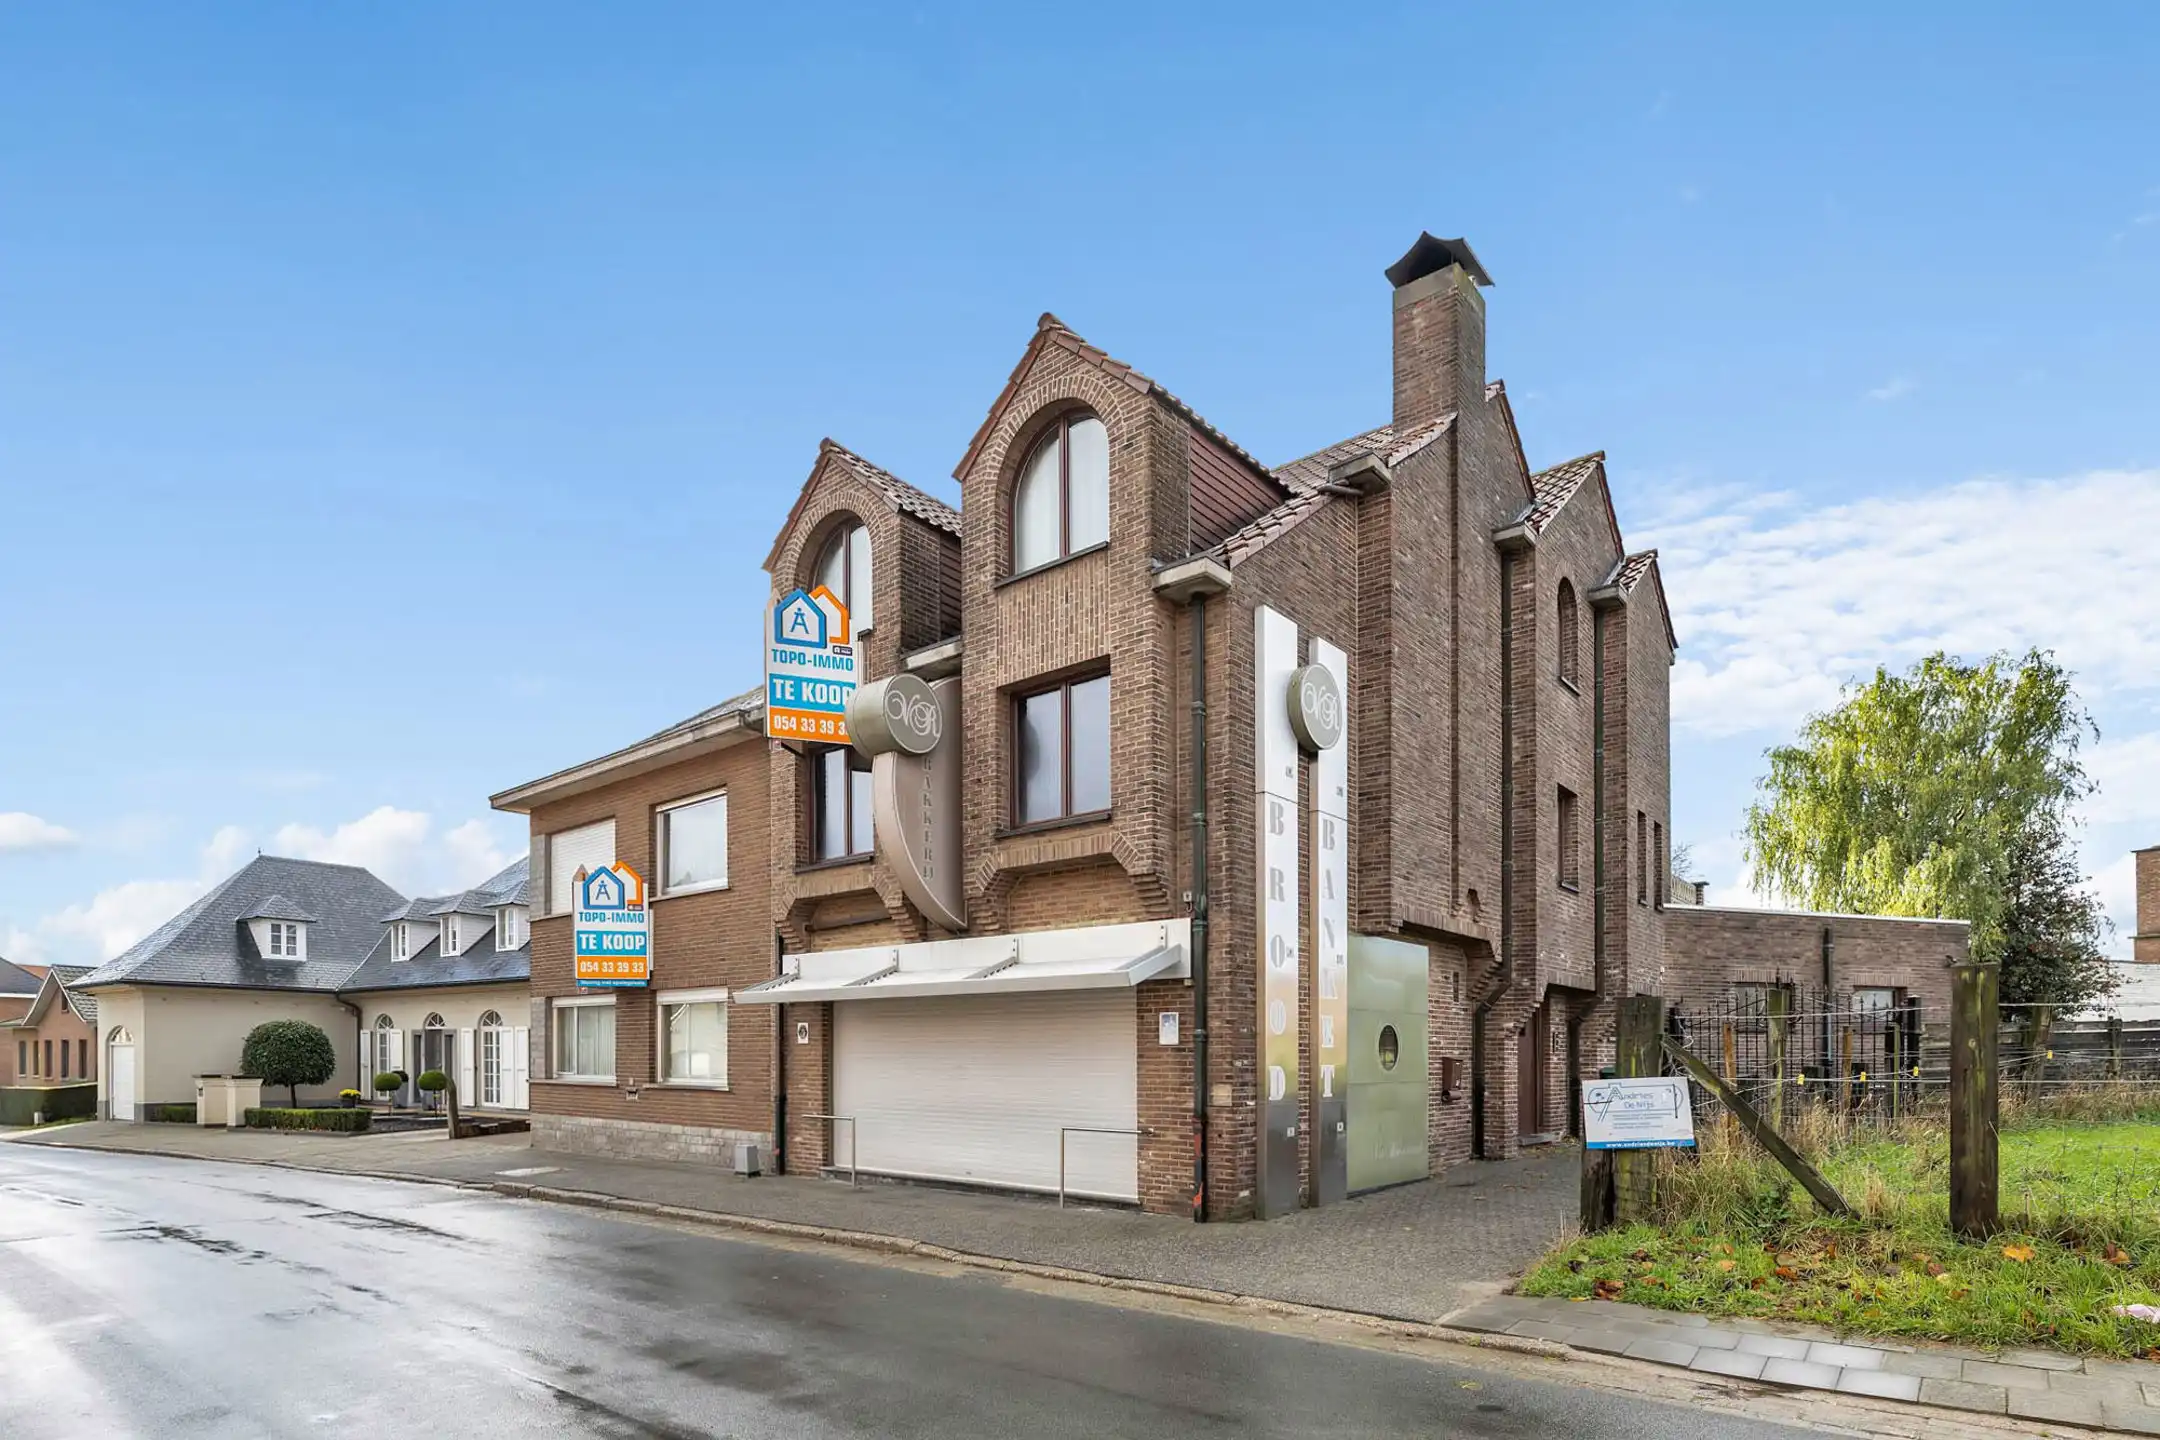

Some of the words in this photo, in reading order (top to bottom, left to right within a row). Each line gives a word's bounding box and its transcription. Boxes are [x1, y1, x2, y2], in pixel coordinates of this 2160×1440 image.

[771, 648, 854, 672] TOPO-IMMO
[773, 678, 795, 701] TE
[773, 714, 797, 731] 054
[800, 717, 816, 733] 33
[819, 719, 835, 735] 39
[838, 721, 849, 736] 3
[578, 911, 645, 923] TOPO-IMMO
[579, 933, 598, 950] TE
[602, 934, 645, 951] KOOP
[1268, 801, 1286, 1101] BROOD
[580, 961, 599, 973] 054
[602, 961, 614, 973] 33
[617, 962, 629, 973] 39
[632, 962, 644, 973] 33
[1321, 819, 1339, 1098] BANKET
